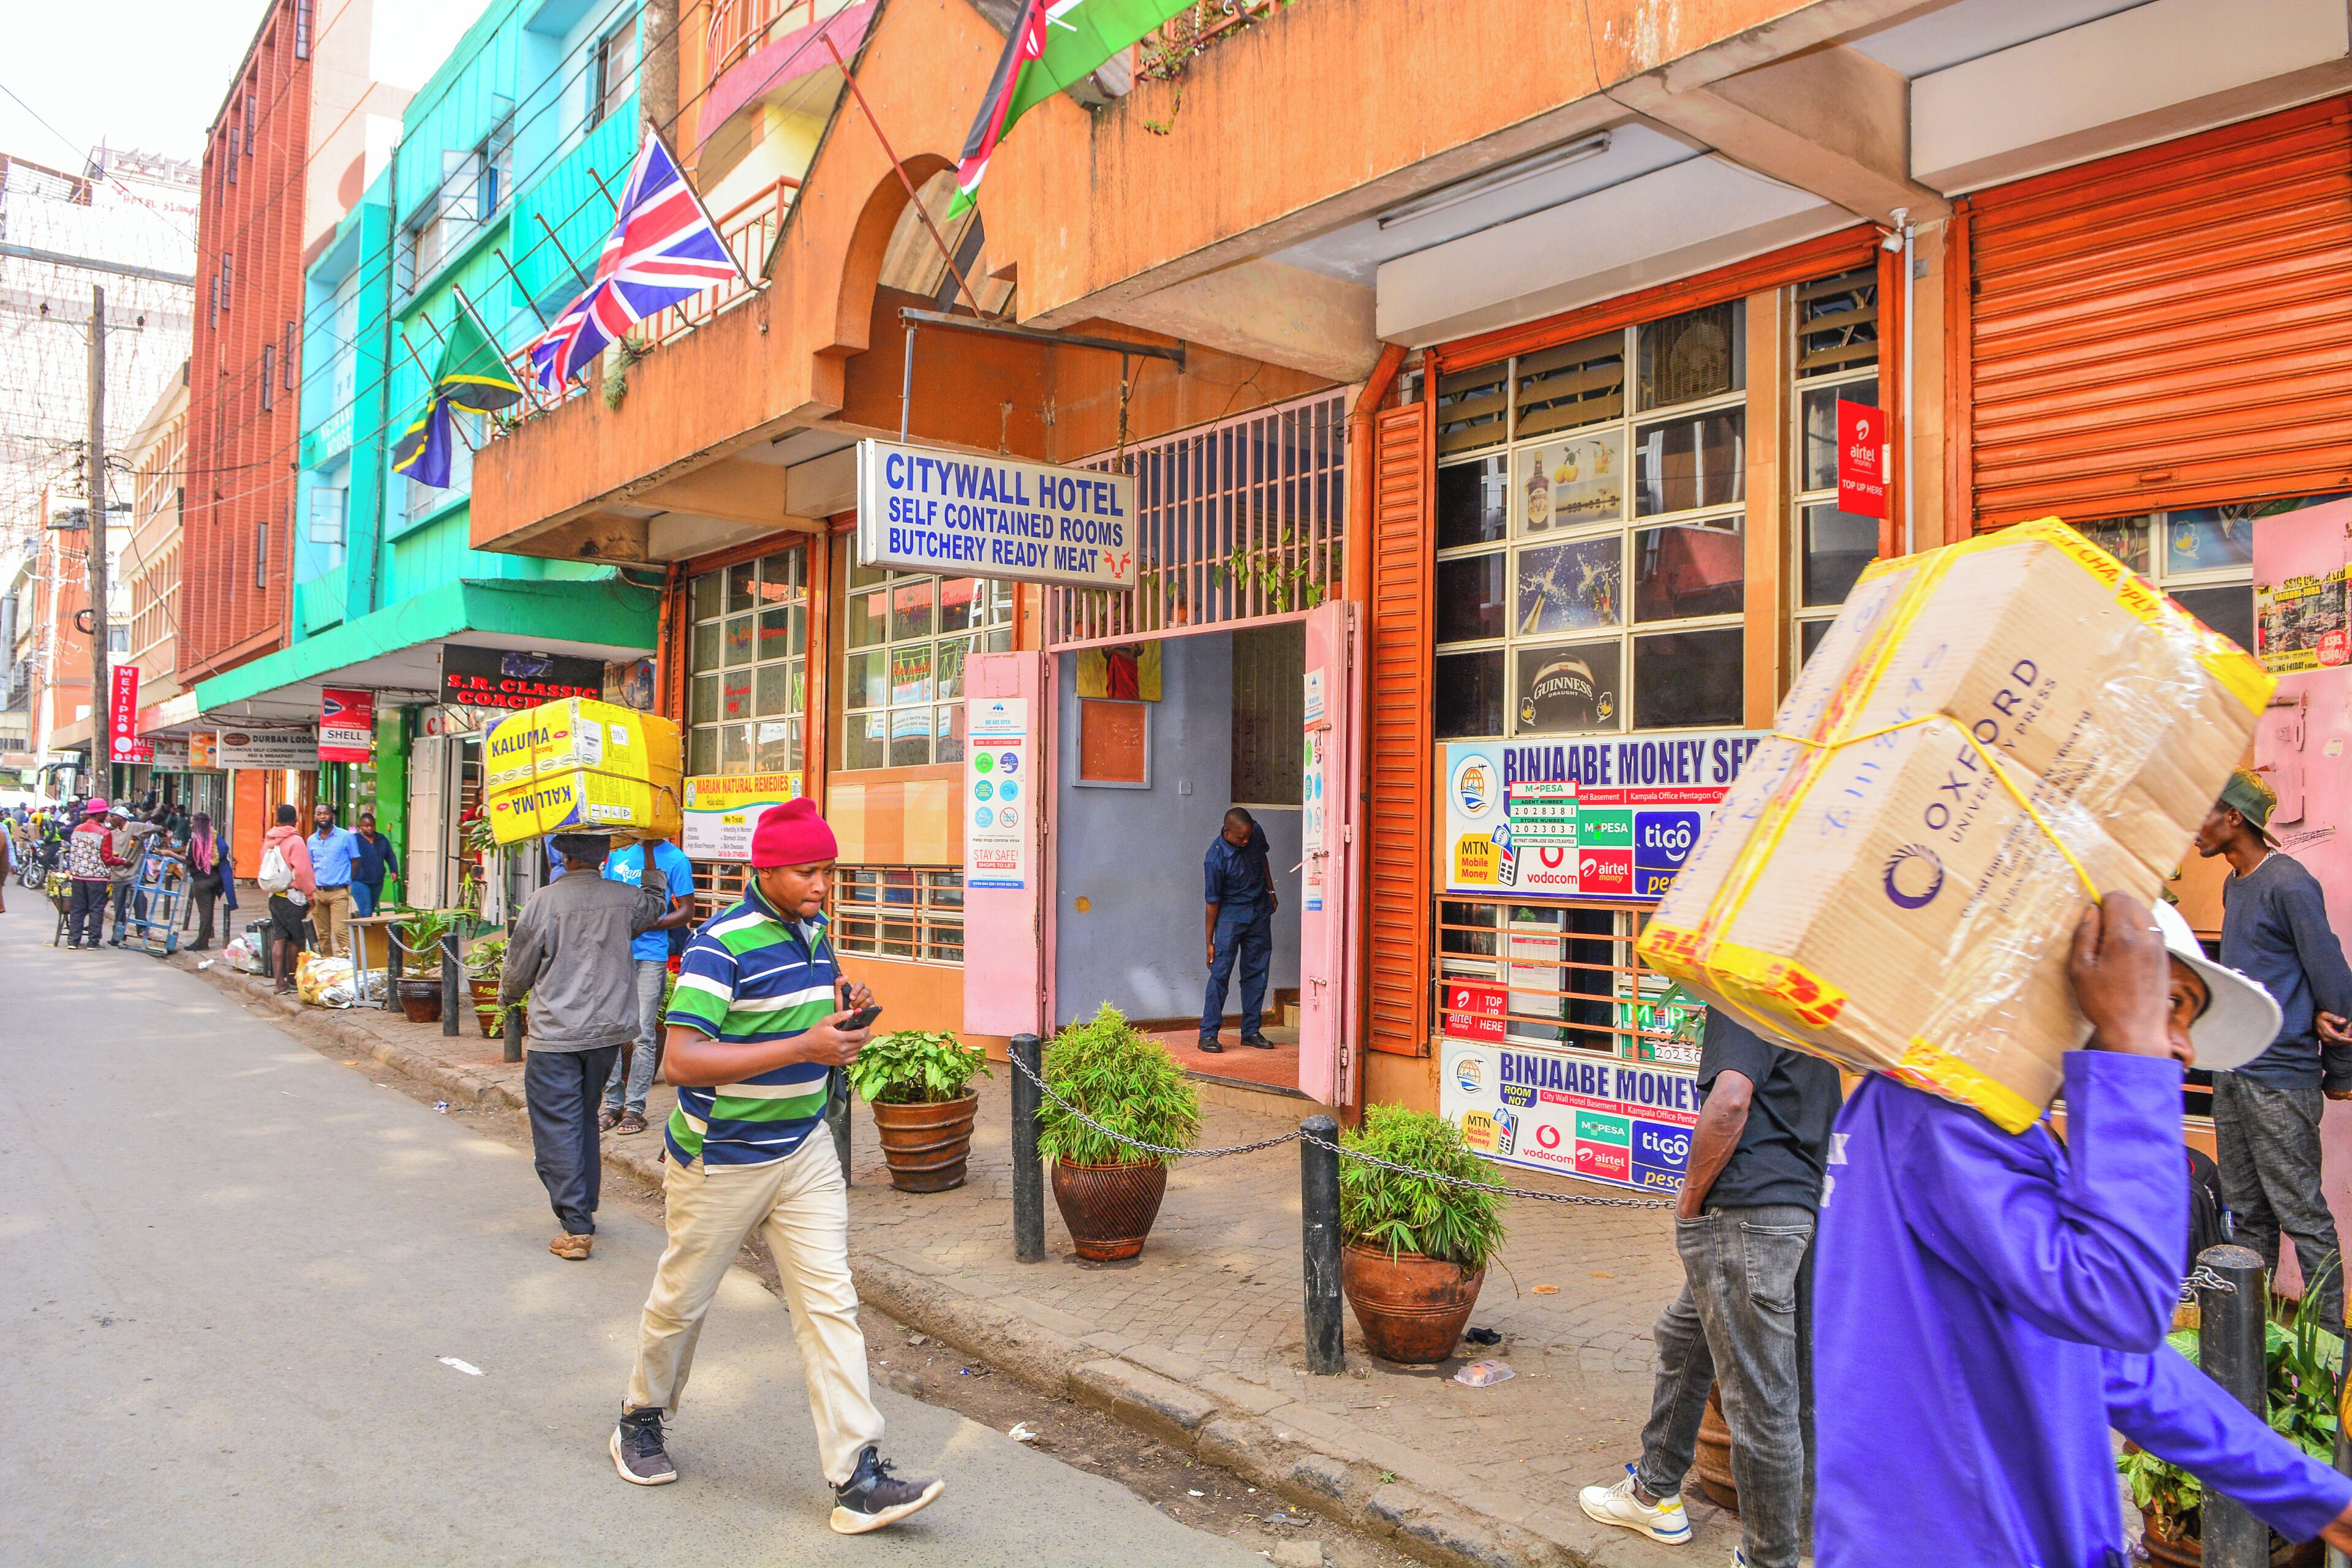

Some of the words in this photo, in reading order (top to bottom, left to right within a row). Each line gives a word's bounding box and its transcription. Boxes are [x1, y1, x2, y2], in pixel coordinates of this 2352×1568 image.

[1850, 443, 1875, 462] airtel
[1853, 458, 1872, 469] money
[886, 453, 1030, 507] CITYWALL
[1039, 474, 1123, 517] HOTEL
[1842, 479, 1856, 489] TOP
[1856, 482, 1866, 492] UP
[1866, 484, 1883, 496] HERE
[889, 496, 938, 526] SELF
[944, 503, 1054, 539] CONTAINED
[1060, 516, 1123, 547] ROOMS
[889, 527, 987, 562] BUTCHERY
[992, 538, 1048, 568] READY
[1054, 546, 1098, 573] MEAT
[2266, 663, 2286, 673] ARTING
[2286, 661, 2305, 670] FRIDAY
[447, 674, 496, 692] S.R.
[500, 679, 598, 699] CLASSIC
[1534, 677, 1593, 700] GUINNESS
[116, 668, 133, 733] MEXIPRO
[457, 690, 544, 709] COACH
[2015, 677, 2057, 735] PRESS
[252, 735, 288, 744] DURBAN
[327, 730, 363, 741] SHELL
[492, 727, 550, 758] KALUMA
[1924, 659, 2038, 829] OXFORD
[1503, 742, 1614, 788] BINJAABE
[1618, 739, 1707, 786] MONEY
[696, 778, 721, 794] MARIAN
[723, 777, 753, 794] NATURAL
[755, 775, 788, 793] REMEDIES
[512, 785, 571, 815] KALUMA
[1630, 792, 1657, 802] Kampala
[1658, 791, 1678, 799] Office
[1679, 791, 1711, 801] Pentagon
[1713, 791, 1725, 801] City
[1645, 822, 1691, 848] tigo
[974, 849, 993, 861] STAY
[995, 850, 1019, 861] SAFE!
[1461, 841, 1488, 855] MTN
[1461, 858, 1488, 867] Mobile
[1599, 864, 1629, 875] airtel
[1461, 869, 1488, 880] Money
[1527, 872, 1578, 884] vodacom
[1599, 874, 1623, 883] money
[1485, 996, 1502, 1007] TOP
[1449, 1014, 1472, 1025] airtel
[1480, 1020, 1503, 1032] HERE
[1656, 1047, 1702, 1063] 20230
[1499, 1051, 1611, 1099] BINJAABE
[1615, 1066, 1700, 1112] MONEY
[1504, 1084, 1532, 1098] ROOM
[1508, 1095, 1527, 1106] NO7
[1542, 1091, 1555, 1102] City
[1555, 1093, 1568, 1104] Wall
[1569, 1095, 1586, 1106] Hotel
[1586, 1099, 1617, 1111] Basement
[1627, 1106, 1655, 1118] Kampala
[1656, 1110, 1676, 1121] Office
[1677, 1114, 1698, 1125] Penta
[1468, 1115, 1491, 1129] MTN
[1467, 1126, 1490, 1137] Mobile
[1467, 1135, 1490, 1147] Money
[1642, 1133, 1689, 1156] tigo
[1523, 1148, 1574, 1165] vodacom
[1595, 1153, 1625, 1167] airtel
[1595, 1161, 1620, 1172] money
